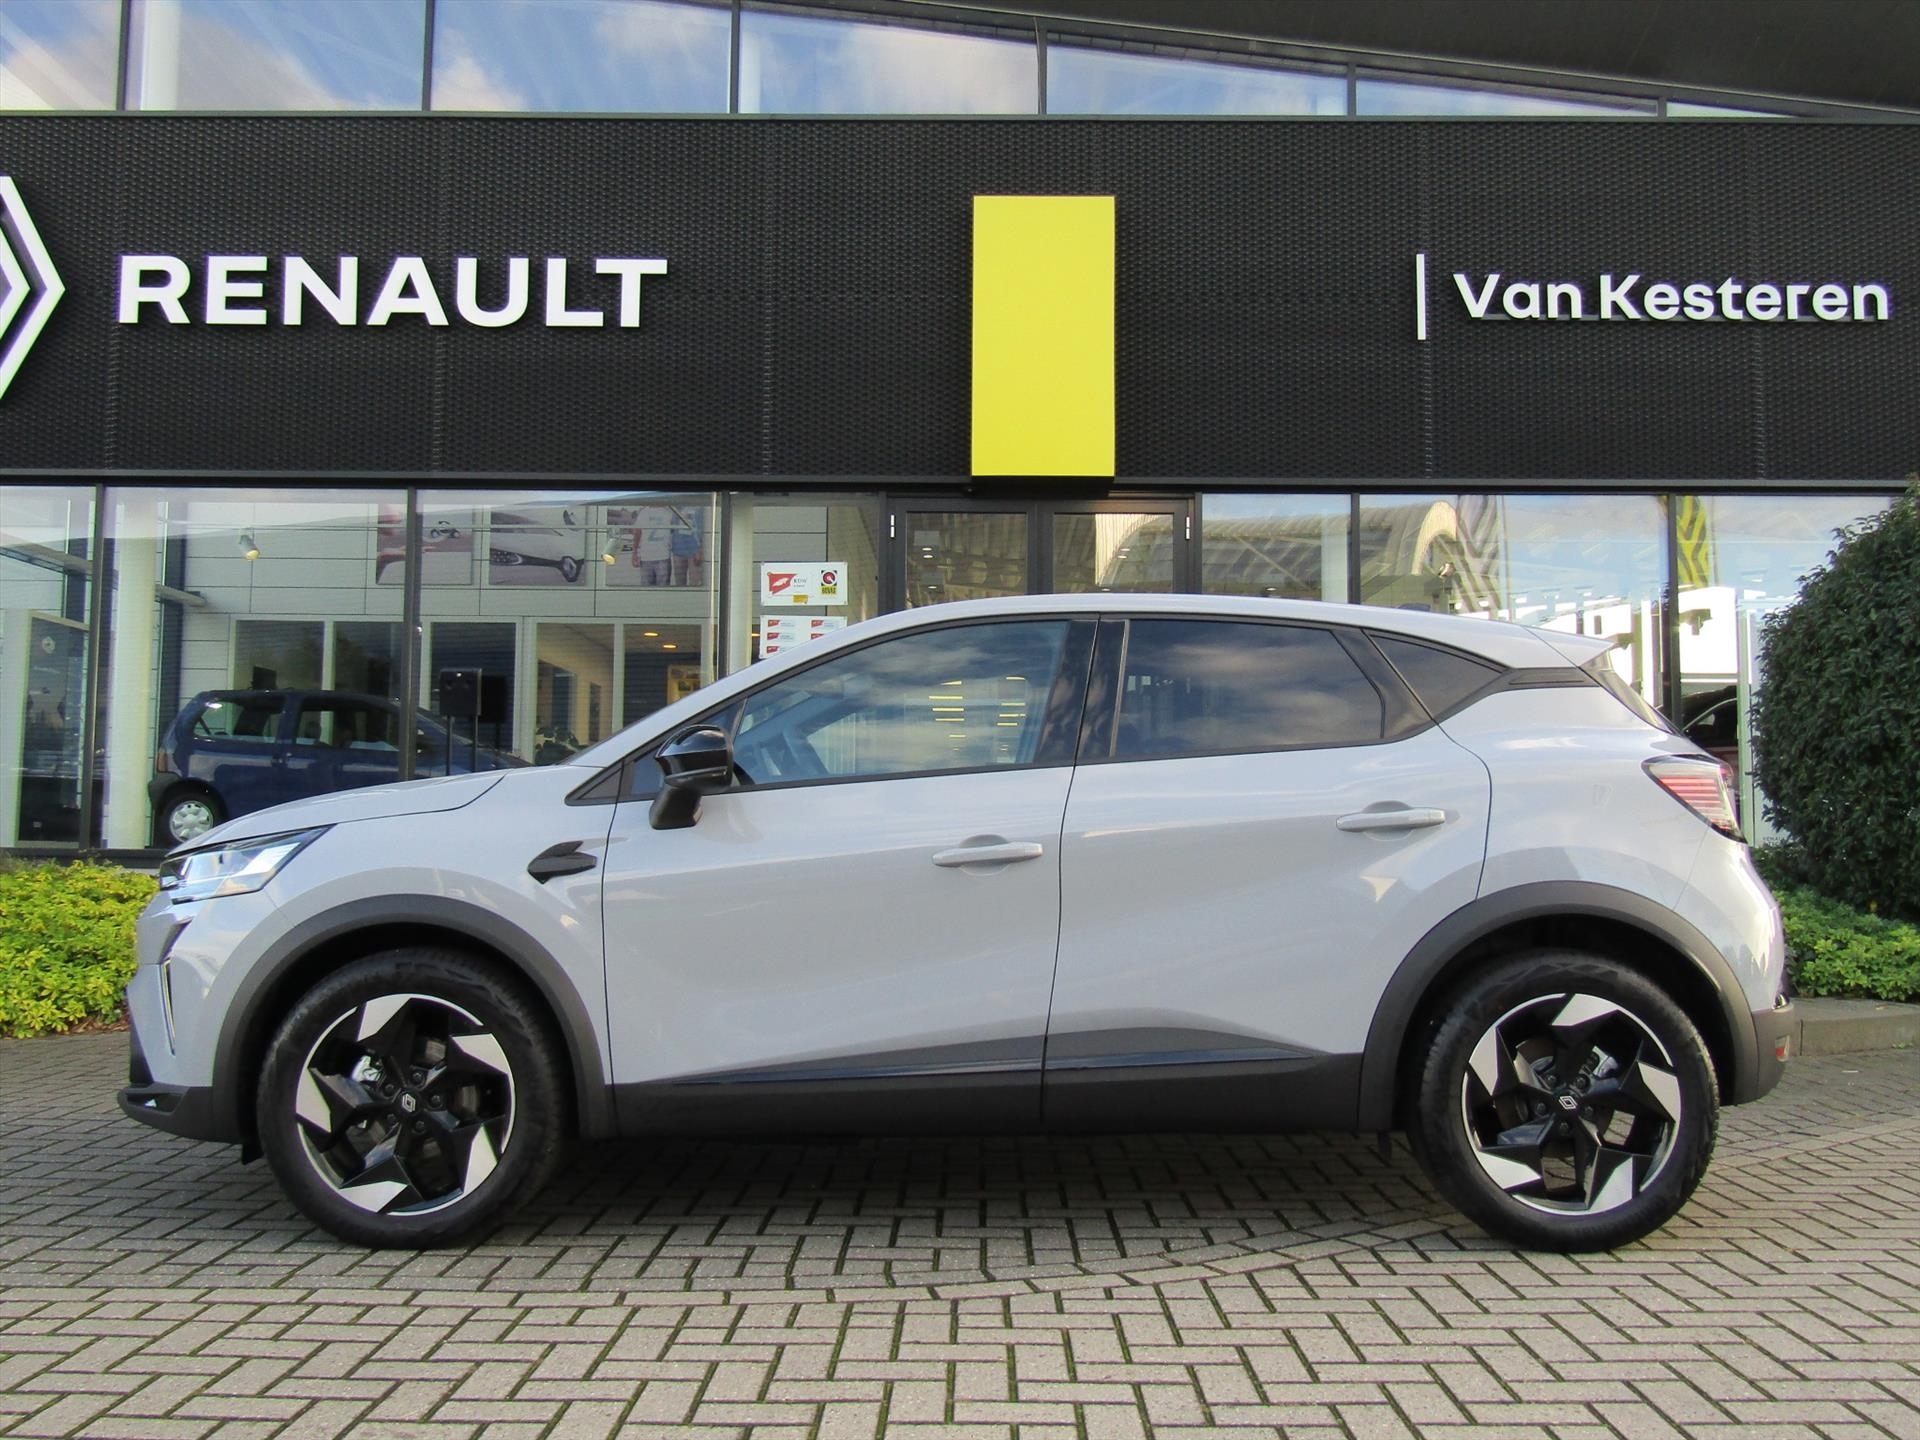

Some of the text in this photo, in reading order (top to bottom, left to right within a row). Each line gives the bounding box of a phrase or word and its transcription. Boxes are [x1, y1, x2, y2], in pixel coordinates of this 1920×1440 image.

[119, 256, 667, 327] RENAULT
[1454, 274, 1888, 320] Van Kesteren
